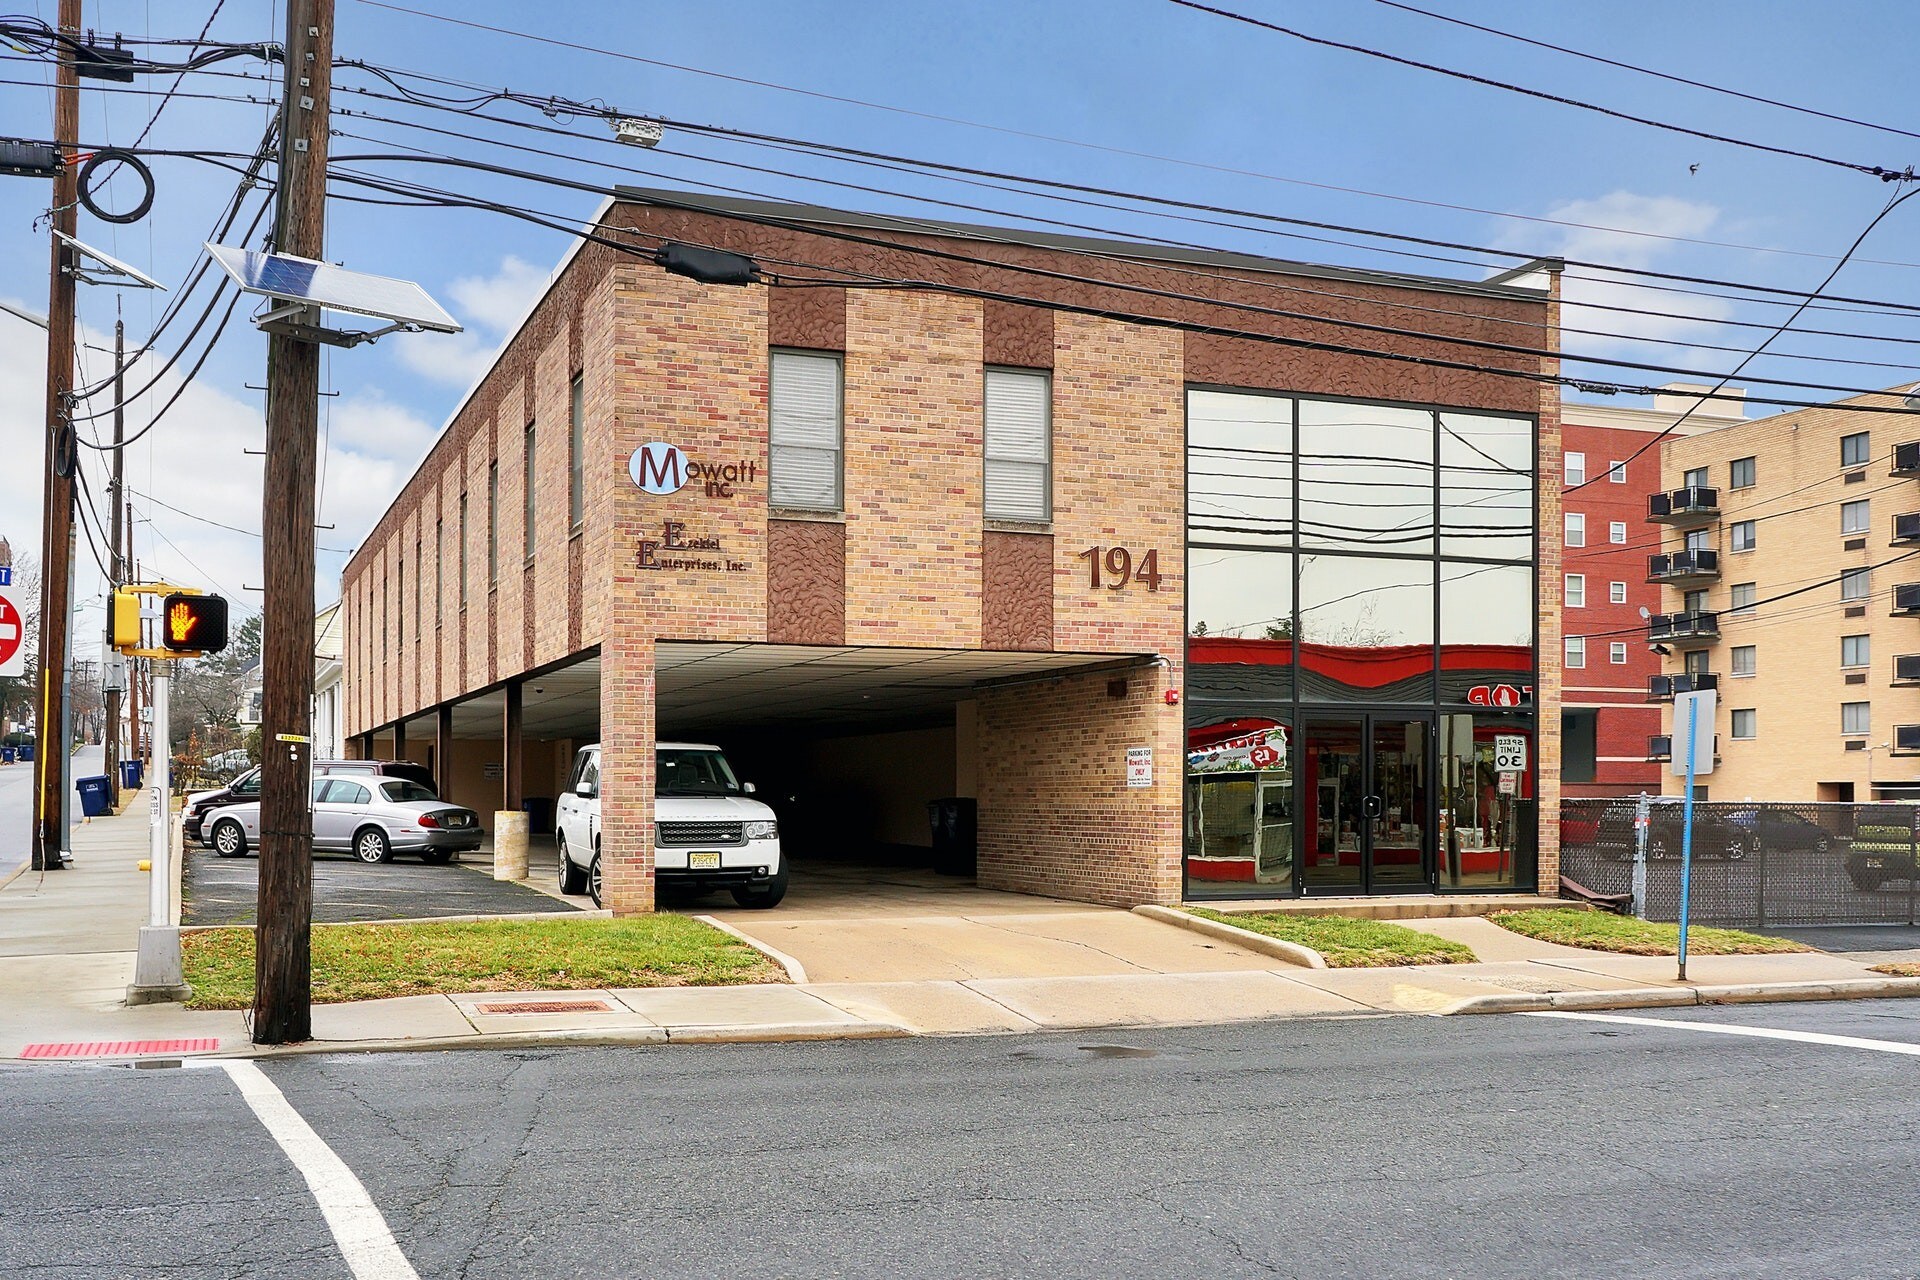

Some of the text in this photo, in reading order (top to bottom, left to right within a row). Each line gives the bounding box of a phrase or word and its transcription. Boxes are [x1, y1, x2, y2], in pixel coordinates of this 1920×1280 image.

[638, 446, 757, 489] Mowatt
[662, 521, 721, 551] Ezekiel
[636, 540, 747, 571] Enterprises, Inc.
[1079, 545, 1162, 592] 194
